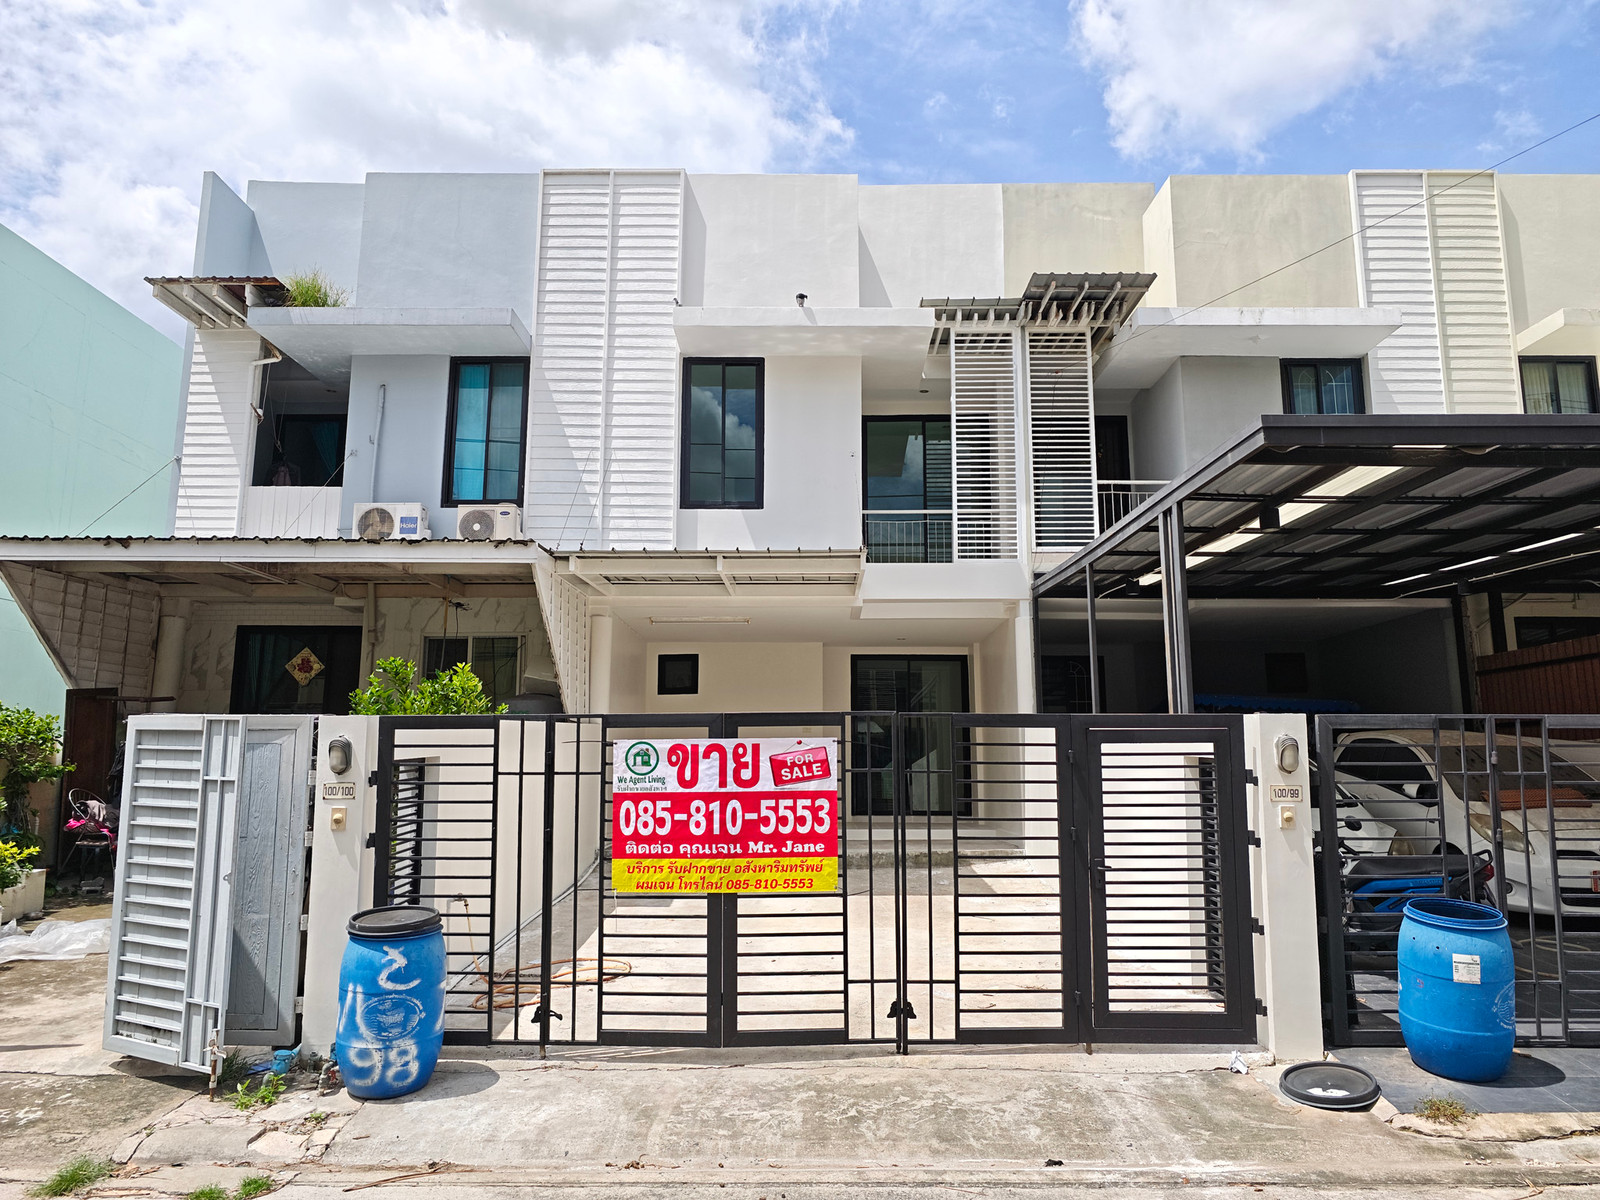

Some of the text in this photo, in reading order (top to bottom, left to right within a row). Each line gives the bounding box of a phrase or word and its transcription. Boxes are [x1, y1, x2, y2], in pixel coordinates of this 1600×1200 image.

[667, 743, 761, 789] ขาย
[786, 753, 814, 766] FOR
[781, 763, 823, 780] SALE
[617, 775, 666, 786] We Agent Living
[324, 786, 354, 796] 100/100
[1273, 788, 1300, 798] 100/99
[619, 798, 831, 836] 085-810-5553
[625, 840, 825, 858] ติดต่อ คุณเจน Mr. Jane
[627, 858, 825, 874] บริการ รับฝากขาย อสังหาริมทรัพย์
[635, 875, 814, 890] ผมเจน โทรไลน์ 085-810-5553
[348, 1039, 419, 1087] 98
